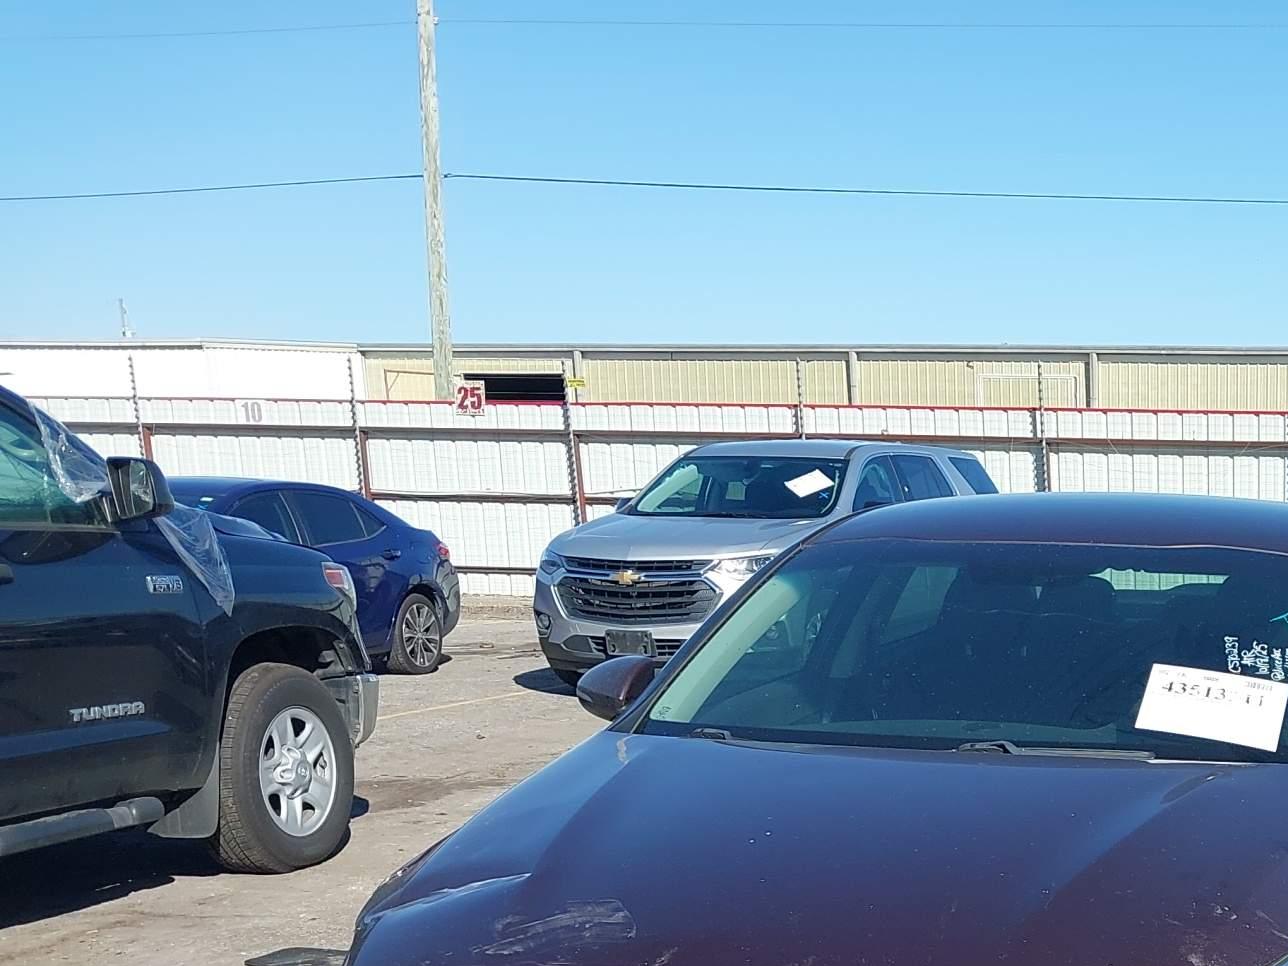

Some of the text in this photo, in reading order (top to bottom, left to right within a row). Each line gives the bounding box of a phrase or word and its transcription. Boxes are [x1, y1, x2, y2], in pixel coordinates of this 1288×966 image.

[457, 387, 482, 410] 25
[241, 401, 263, 423] 10
[69, 701, 145, 722] TUNDRA
